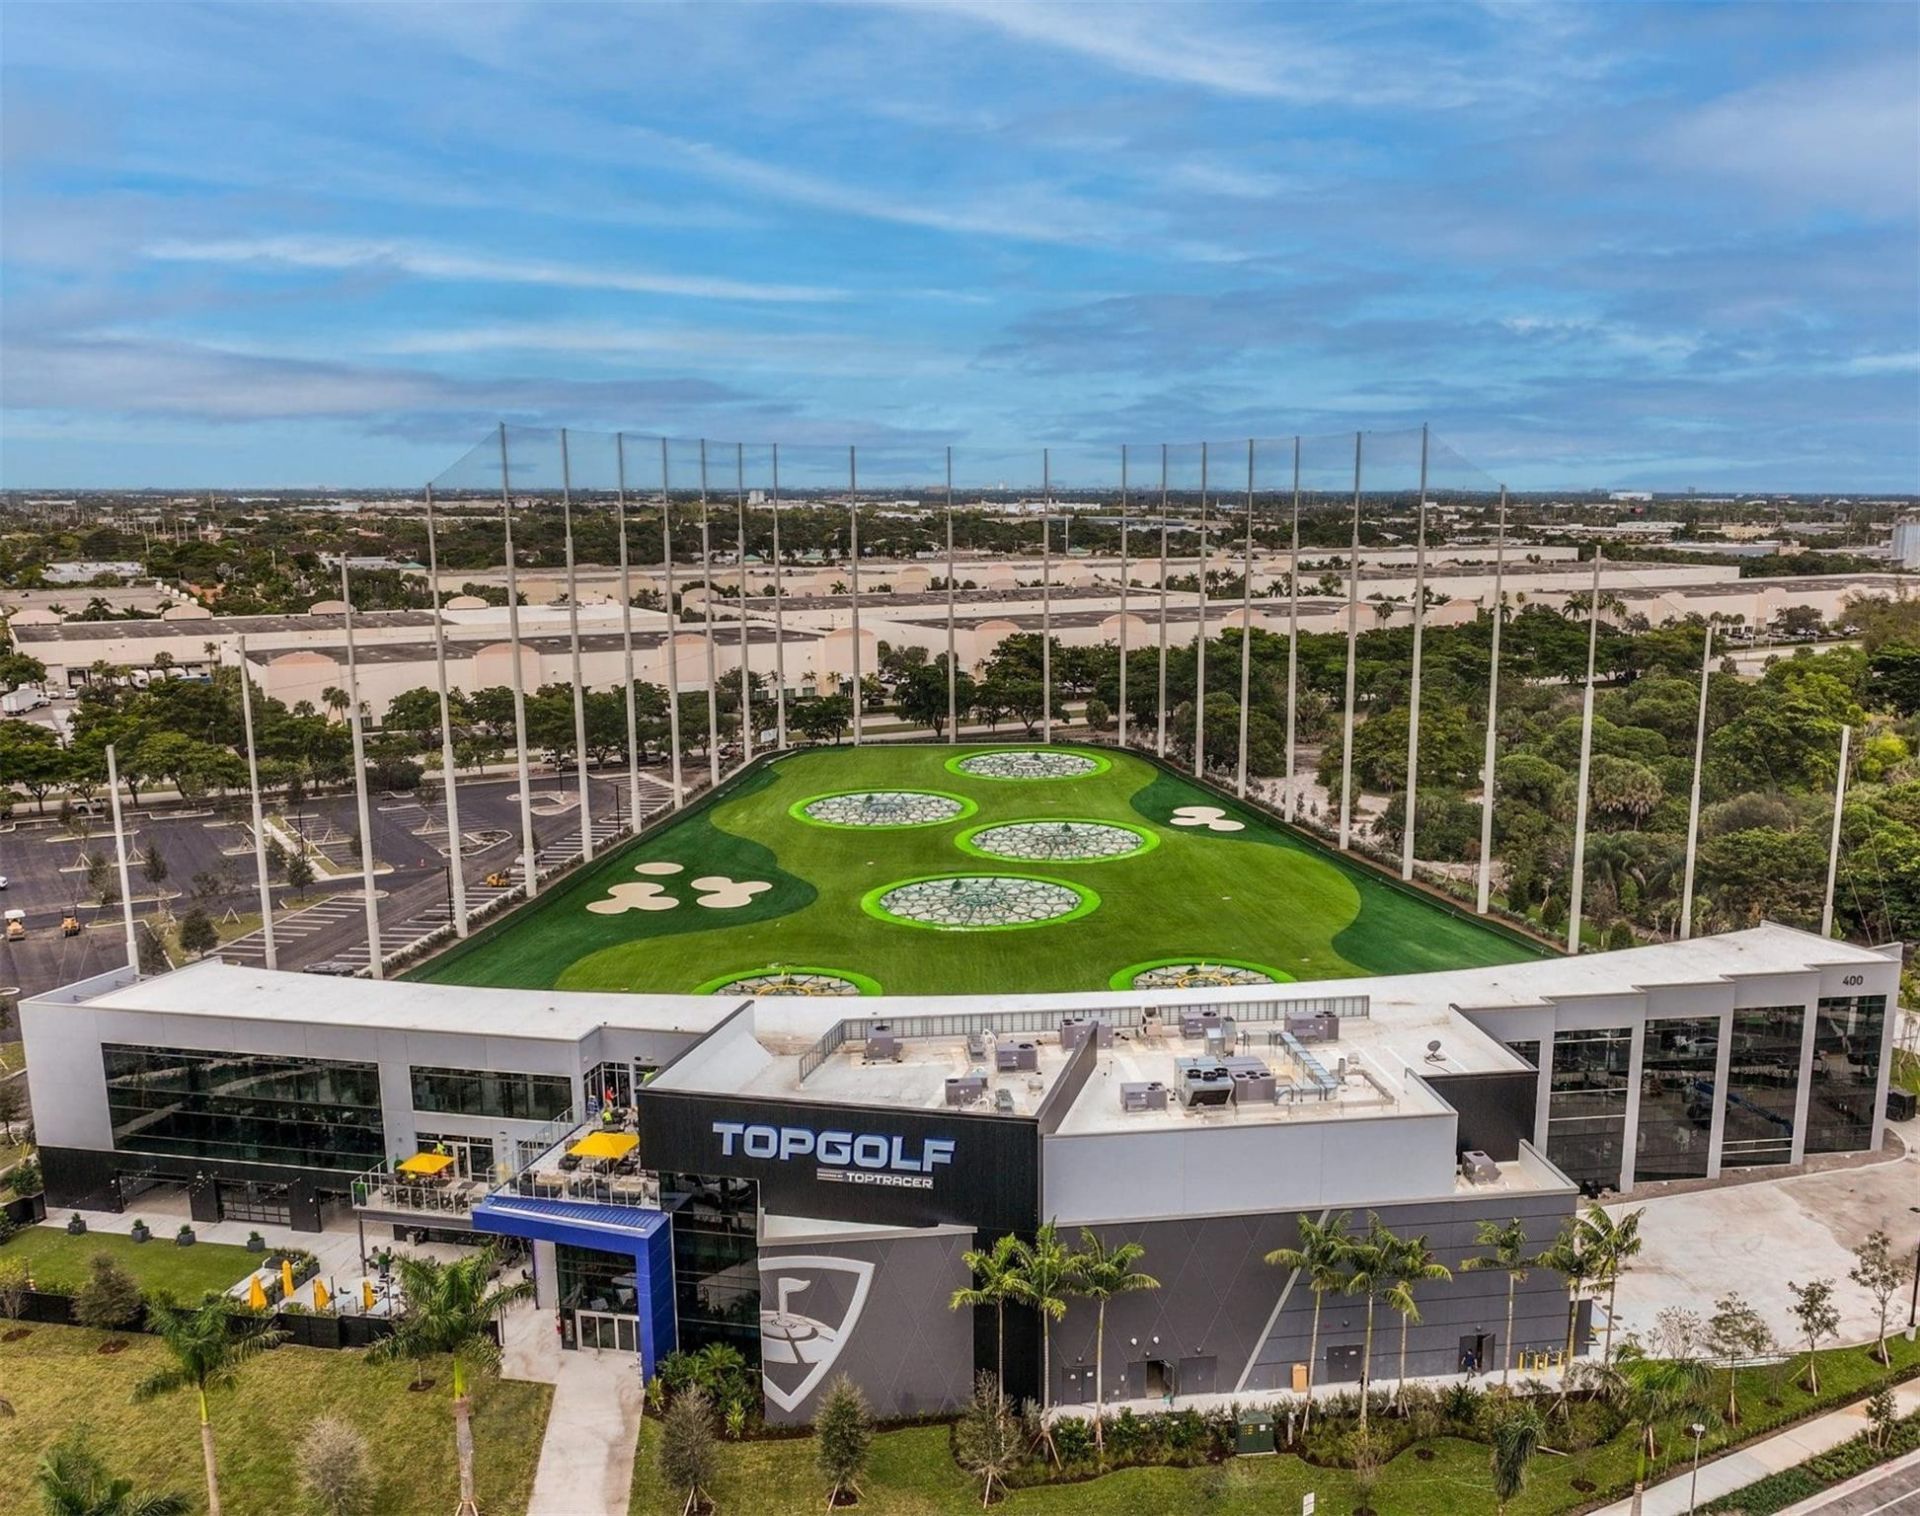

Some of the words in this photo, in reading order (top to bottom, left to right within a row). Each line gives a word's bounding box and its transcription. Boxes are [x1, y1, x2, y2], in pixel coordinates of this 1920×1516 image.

[1842, 975, 1864, 986] 400
[712, 1121, 956, 1172] TOPGOLF
[846, 1172, 934, 1190] TOPTRACER
